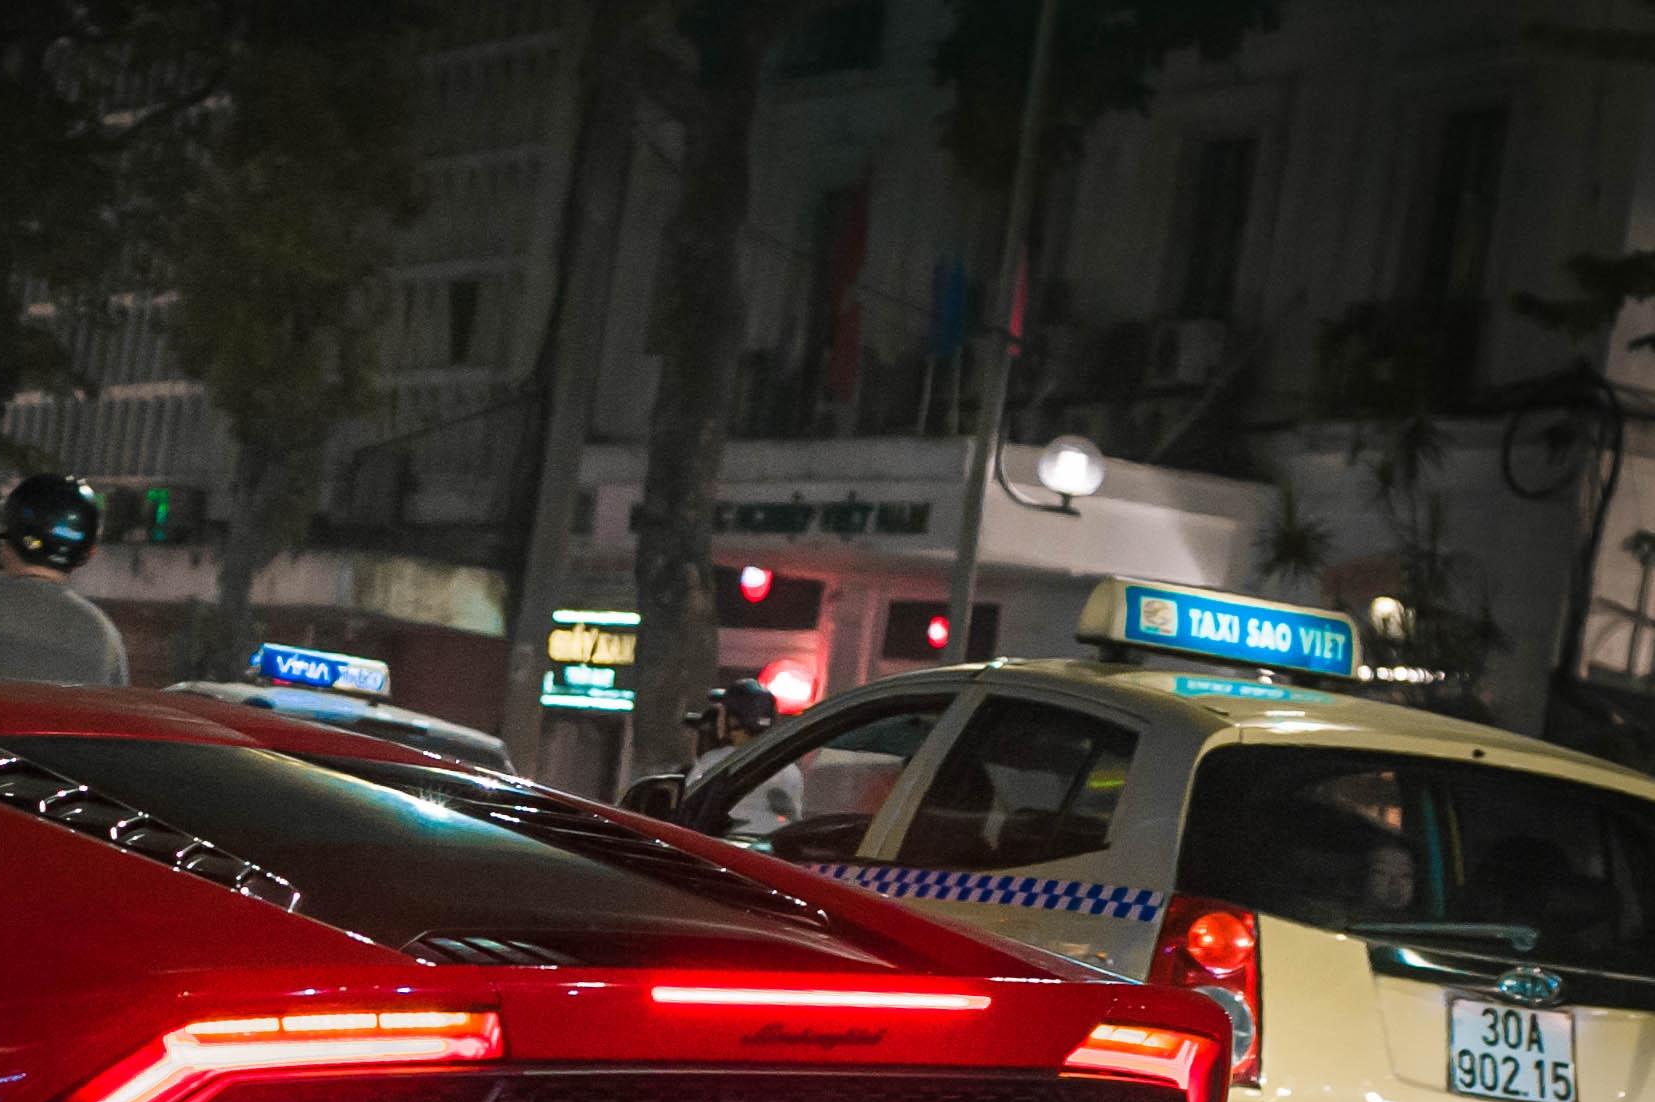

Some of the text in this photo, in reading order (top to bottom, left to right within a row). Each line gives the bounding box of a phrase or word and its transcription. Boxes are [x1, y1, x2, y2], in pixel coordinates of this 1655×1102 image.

[1188, 608, 1240, 644] TAXI
[1245, 618, 1293, 652] SAO
[1482, 1008, 1545, 1053] 30A
[1457, 1049, 1573, 1101] 902.15
